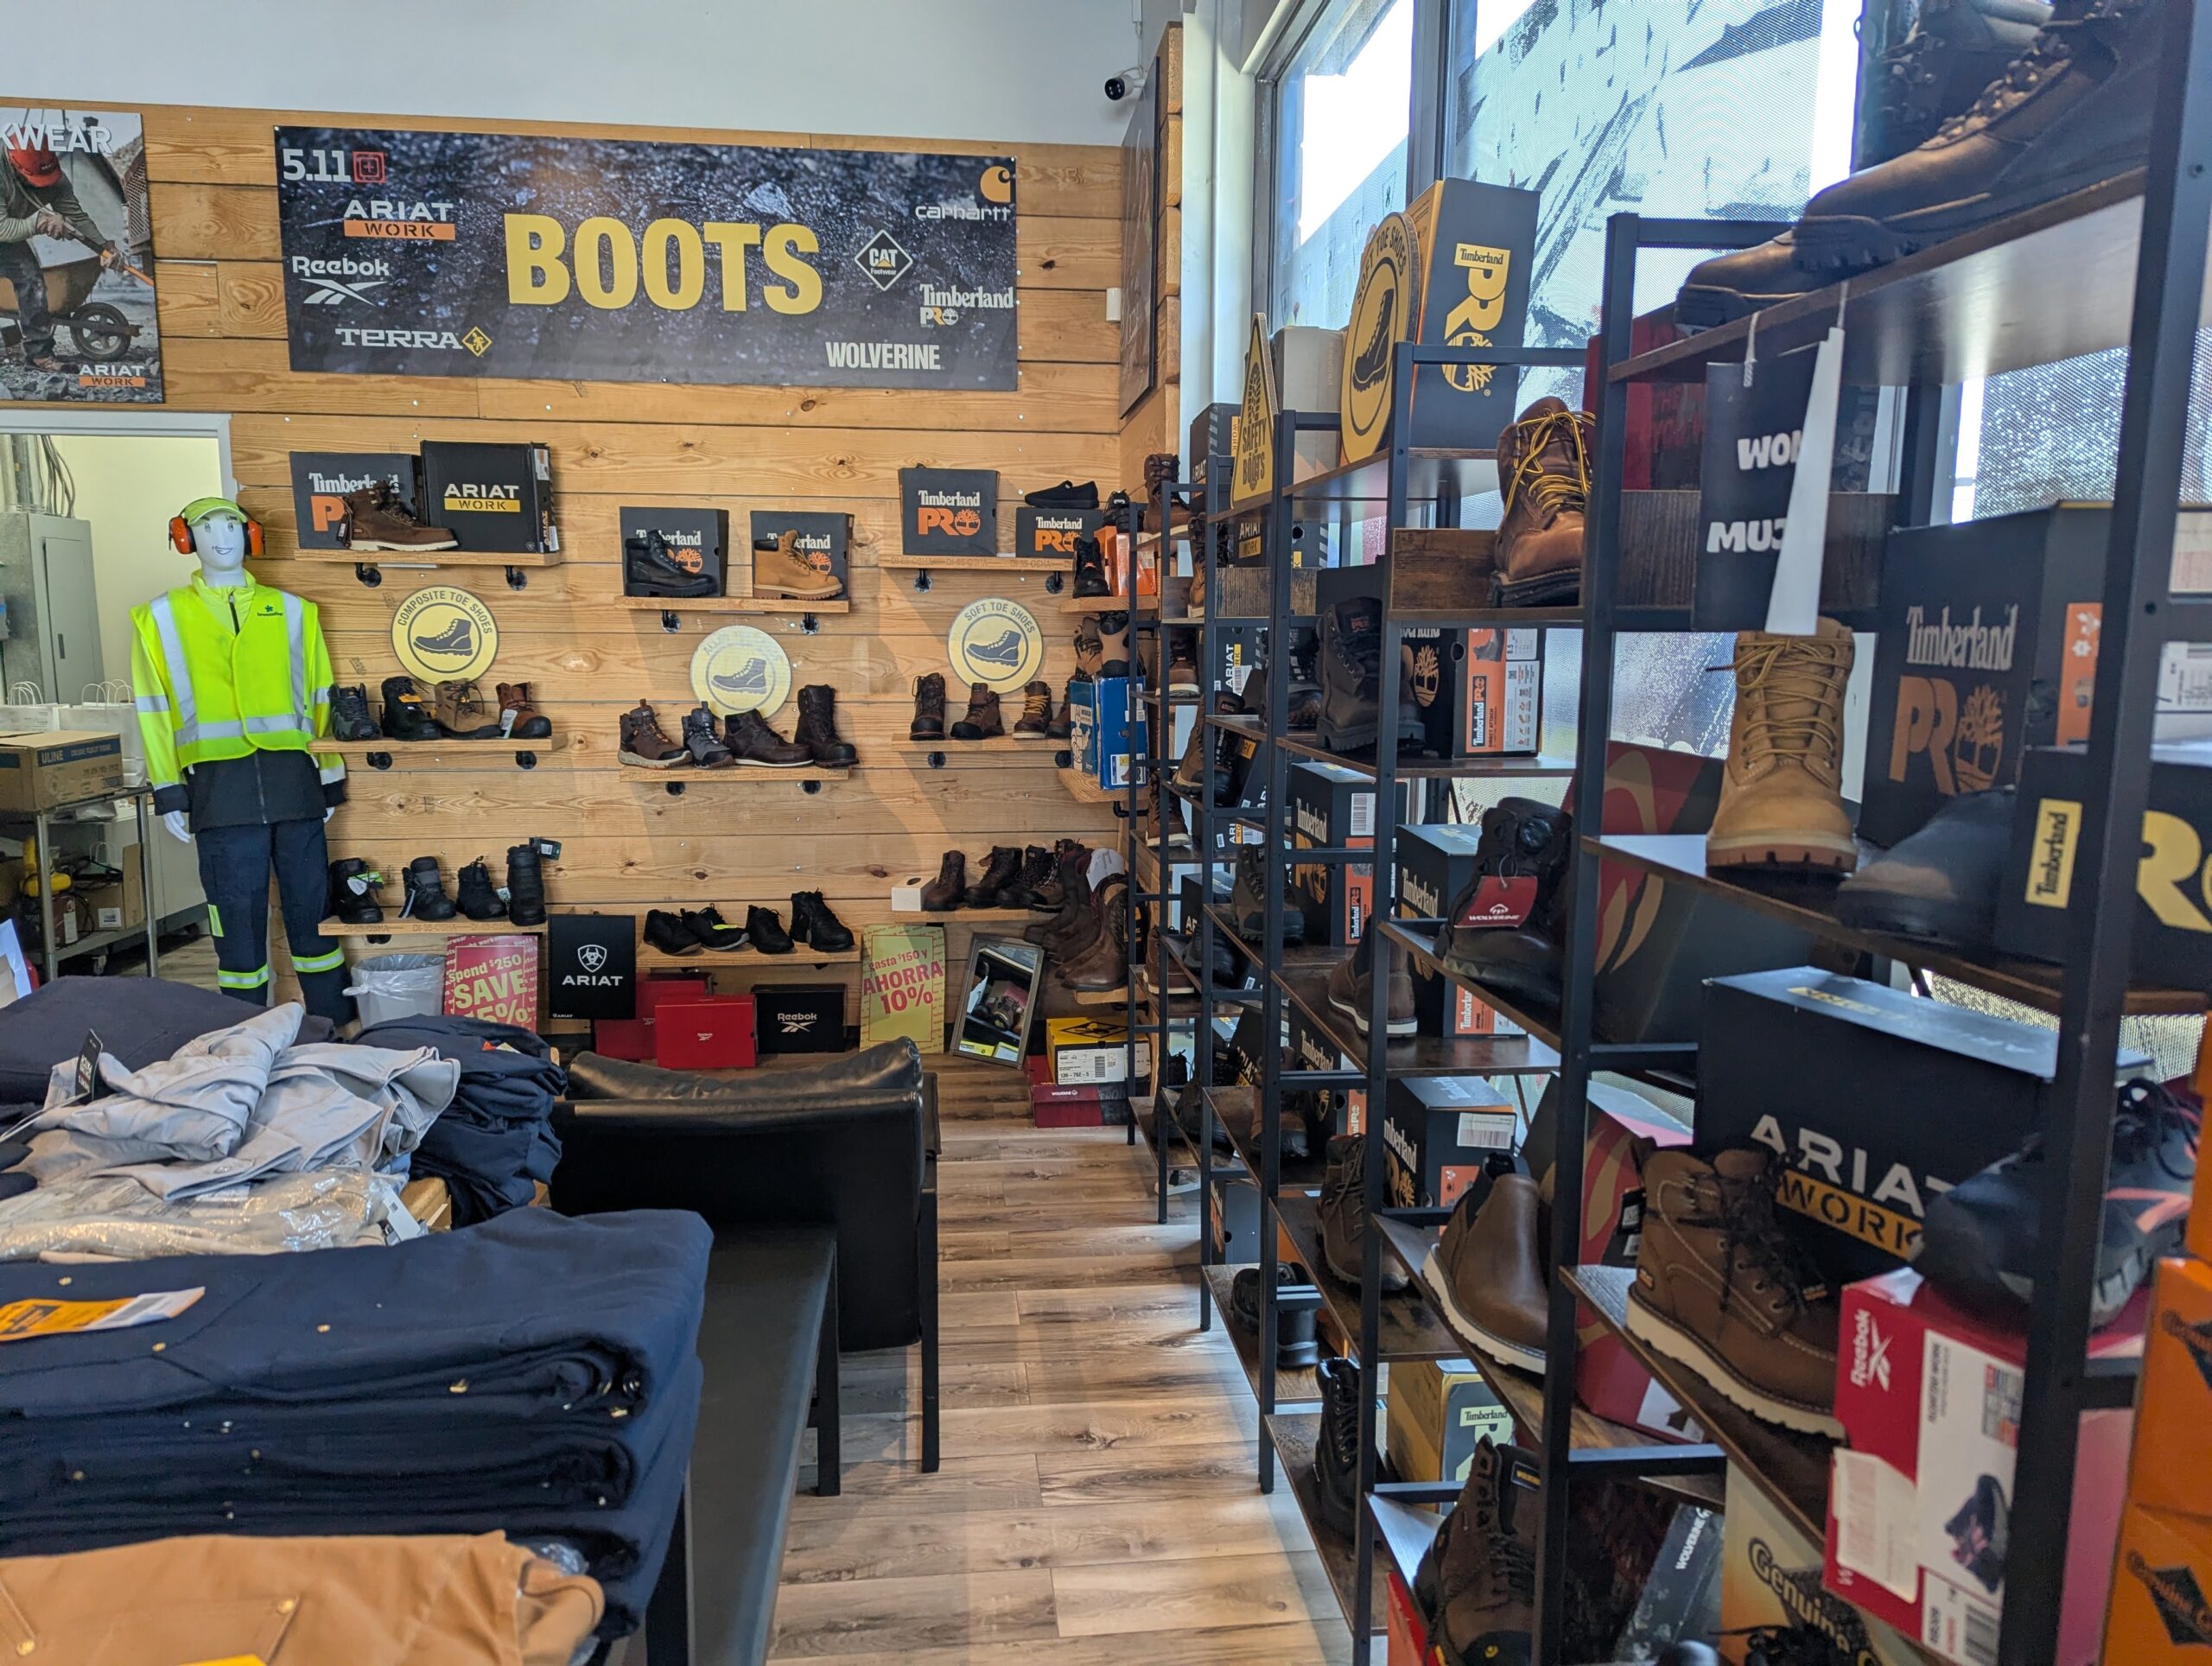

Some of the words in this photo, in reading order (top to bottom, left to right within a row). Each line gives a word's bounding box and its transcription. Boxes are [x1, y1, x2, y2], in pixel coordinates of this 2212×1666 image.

[283, 149, 351, 182] 5.11
[344, 200, 454, 222] ARIAT
[915, 206, 1011, 221] carhartt
[365, 221, 436, 238] WORK
[291, 257, 391, 277] Reebok
[504, 213, 823, 315] BOOTS
[869, 248, 898, 268] CAT
[1357, 248, 1374, 304] SOFT
[1376, 226, 1389, 257] TOE
[1389, 226, 1407, 277] SHOES
[1459, 248, 1504, 265] Timberland
[919, 283, 1014, 308] Timberland
[79, 364, 145, 377] ARIAT
[825, 341, 941, 371] WOLVERINE
[92, 377, 134, 386] WORK
[1243, 418, 1268, 452] SAFETY
[444, 483, 519, 499] ARIAT
[459, 499, 507, 510] WORK
[918, 490, 981, 507] Timberland
[1035, 516, 1082, 530] Timberland
[397, 590, 447, 626] COMPOSITE
[449, 591, 470, 607] TOE
[469, 603, 493, 634] SHOES
[964, 603, 987, 621] SOFT
[989, 601, 1009, 613] TOE
[1010, 607, 1035, 634] SHOES
[1905, 604, 2019, 671] Timberland
[1225, 644, 1235, 688] ARIAT
[1473, 703, 1484, 746] Timberland
[41, 749, 64, 763] ULINE
[1296, 797, 1327, 844] Timberland
[2036, 811, 2069, 896] Timberland
[1402, 867, 1439, 919] Timberland
[1351, 907, 1360, 939] Timberland
[448, 963, 488, 983] Spend
[489, 954, 522, 970] $250
[868, 957, 897, 972] gasta
[898, 950, 920, 963] $150
[920, 949, 928, 959] y
[454, 970, 527, 1009] SAVE
[562, 975, 624, 987] ARIAT
[863, 961, 944, 996] AHORRA
[880, 983, 934, 1014] 10%
[777, 1013, 817, 1022] Reebok
[1300, 1029, 1334, 1071] Timberland
[1383, 1116, 1418, 1173] mberland
[1782, 1174, 1923, 1250] WORK
[1850, 1308, 1872, 1388] Reebok
[1465, 1409, 1509, 1421] Timberland
[1675, 1516, 1707, 1570] WOLVERINE
